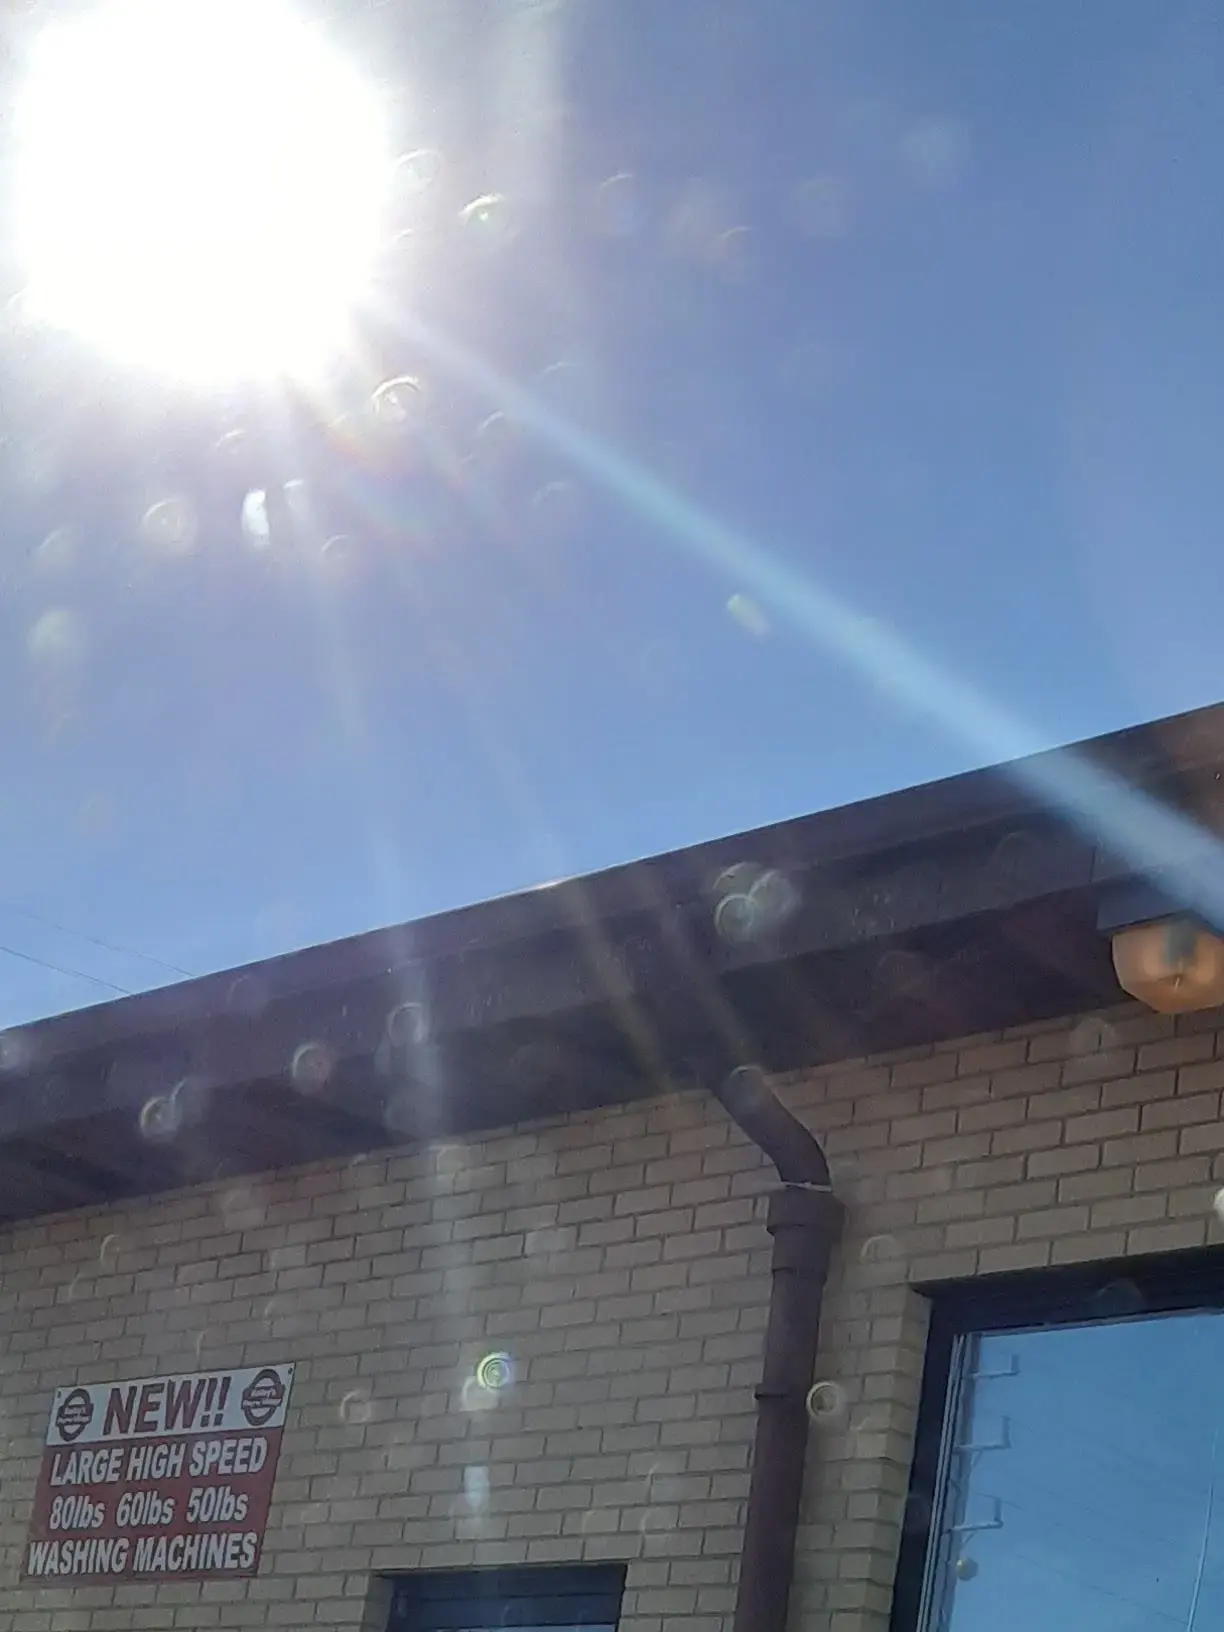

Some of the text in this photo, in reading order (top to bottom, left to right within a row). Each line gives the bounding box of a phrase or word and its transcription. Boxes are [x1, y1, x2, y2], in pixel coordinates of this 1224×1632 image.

[103, 1376, 231, 1435] NEW!!
[50, 1437, 268, 1486] LARGE HIGH SPEED
[50, 1486, 249, 1530] 80lbs 60lbs 50lbs
[27, 1532, 258, 1576] WASHING MACHINES
